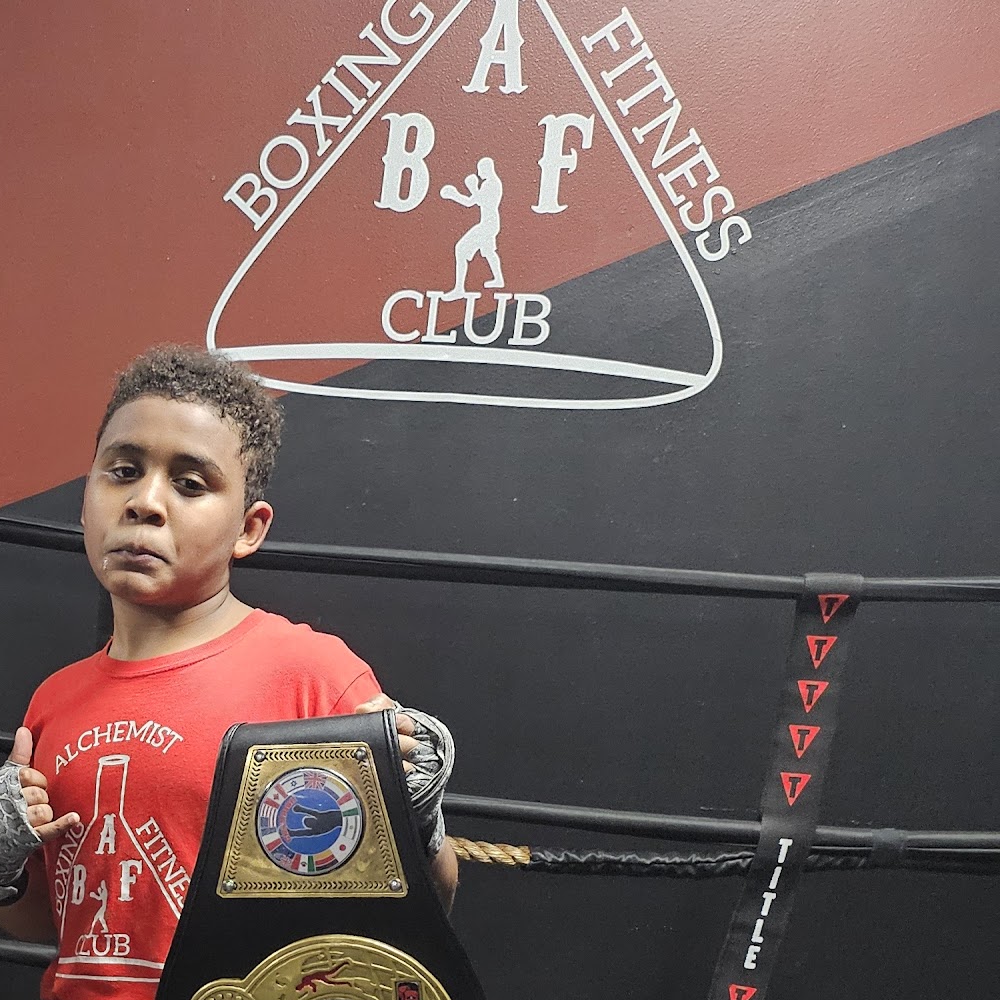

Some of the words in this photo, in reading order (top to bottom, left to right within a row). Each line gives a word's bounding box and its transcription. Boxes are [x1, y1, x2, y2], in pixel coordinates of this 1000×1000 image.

[462, 0, 529, 94] A
[222, 0, 434, 230] BOXING
[581, 7, 753, 262] FITNESS
[373, 113, 435, 212] B
[531, 113, 596, 213] F
[381, 290, 552, 346] CLUB
[54, 720, 184, 775] ALCHEMIST
[95, 813, 117, 855] A
[71, 864, 87, 905] B
[118, 859, 143, 901] F
[744, 838, 793, 969] TITLE
